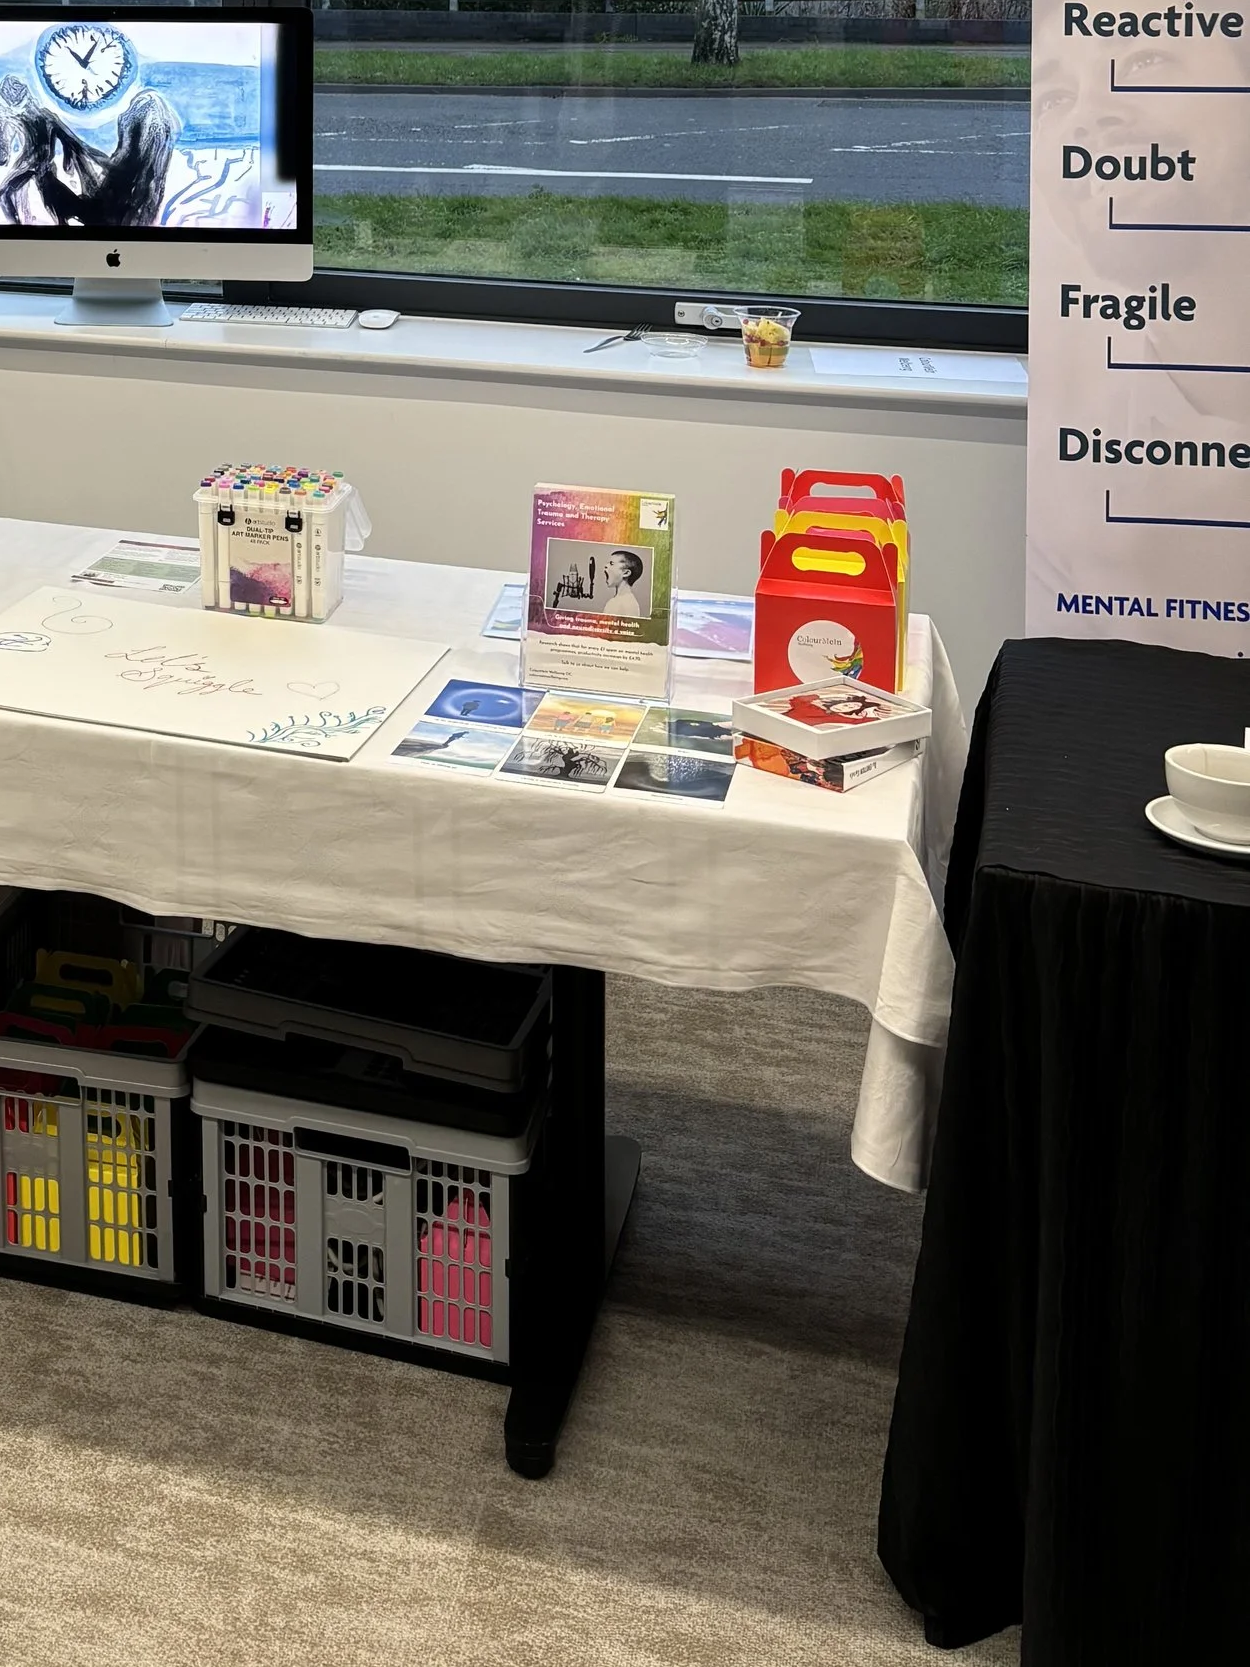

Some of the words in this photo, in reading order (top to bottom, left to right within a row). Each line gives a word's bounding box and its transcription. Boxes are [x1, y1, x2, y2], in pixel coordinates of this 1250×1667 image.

[1064, 2, 1244, 38] Reactive
[1062, 143, 1196, 181] Doubt
[1061, 284, 1196, 330] Fragile
[1059, 427, 1250, 467] Disconne
[537, 518, 565, 527] Services
[538, 509, 563, 518] Trauma
[566, 511, 578, 519] and
[581, 512, 610, 523] Therapy
[579, 503, 615, 512] Emotional
[1056, 593, 1158, 617] MENTAL
[1166, 598, 1250, 622] FITNES
